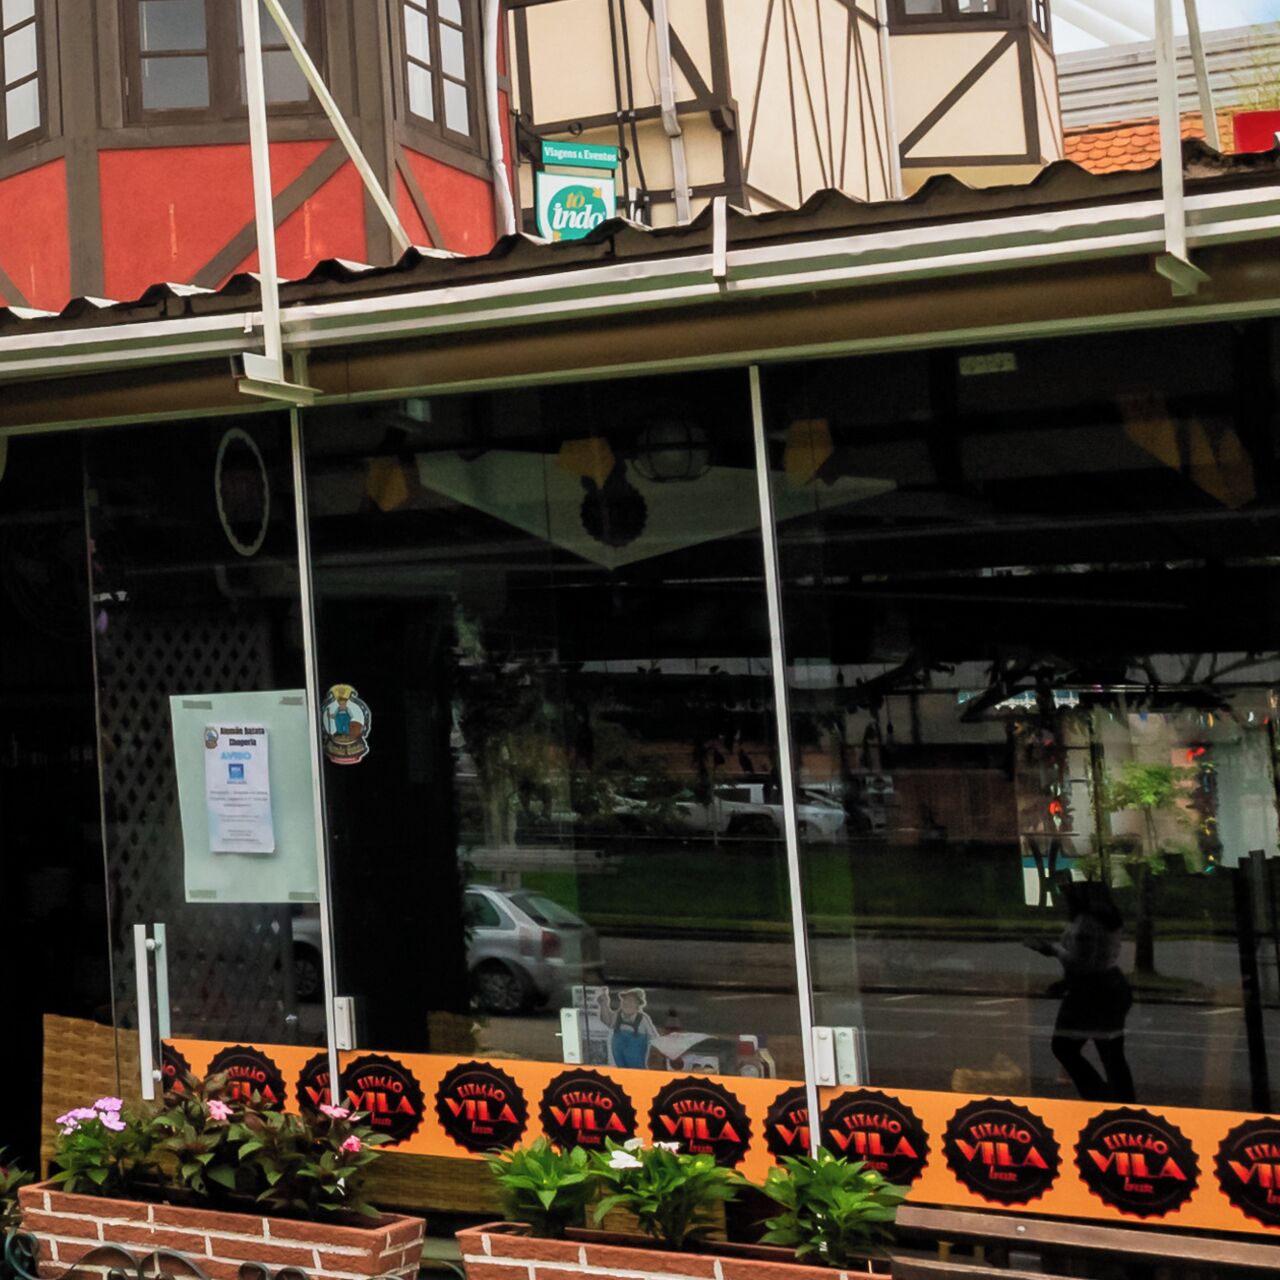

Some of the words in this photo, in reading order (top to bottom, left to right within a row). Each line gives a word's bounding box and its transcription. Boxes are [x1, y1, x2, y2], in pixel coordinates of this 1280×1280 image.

[544, 147, 577, 160] Viagens
[584, 150, 616, 161] Eventos
[552, 203, 604, 229] indo
[229, 1081, 278, 1104] ILA
[357, 1075, 403, 1093] ESTAÇÃO
[457, 1083, 505, 1102] ESTAÇÃO
[346, 1090, 416, 1115] VILA
[444, 1098, 519, 1124] VILA
[561, 1091, 613, 1110] ESTAÇÃO
[672, 1100, 726, 1119] ESTAÇÃO
[549, 1105, 627, 1133] VILA
[659, 1115, 741, 1143] VILA
[843, 1113, 902, 1134] ESTAÇÃO
[829, 1129, 918, 1158] VILA
[970, 1123, 1031, 1144] ESTAÇÃO
[1103, 1133, 1168, 1154] ESTAÇÃO
[955, 1139, 1049, 1169] VILA
[1087, 1149, 1187, 1181] VILA
